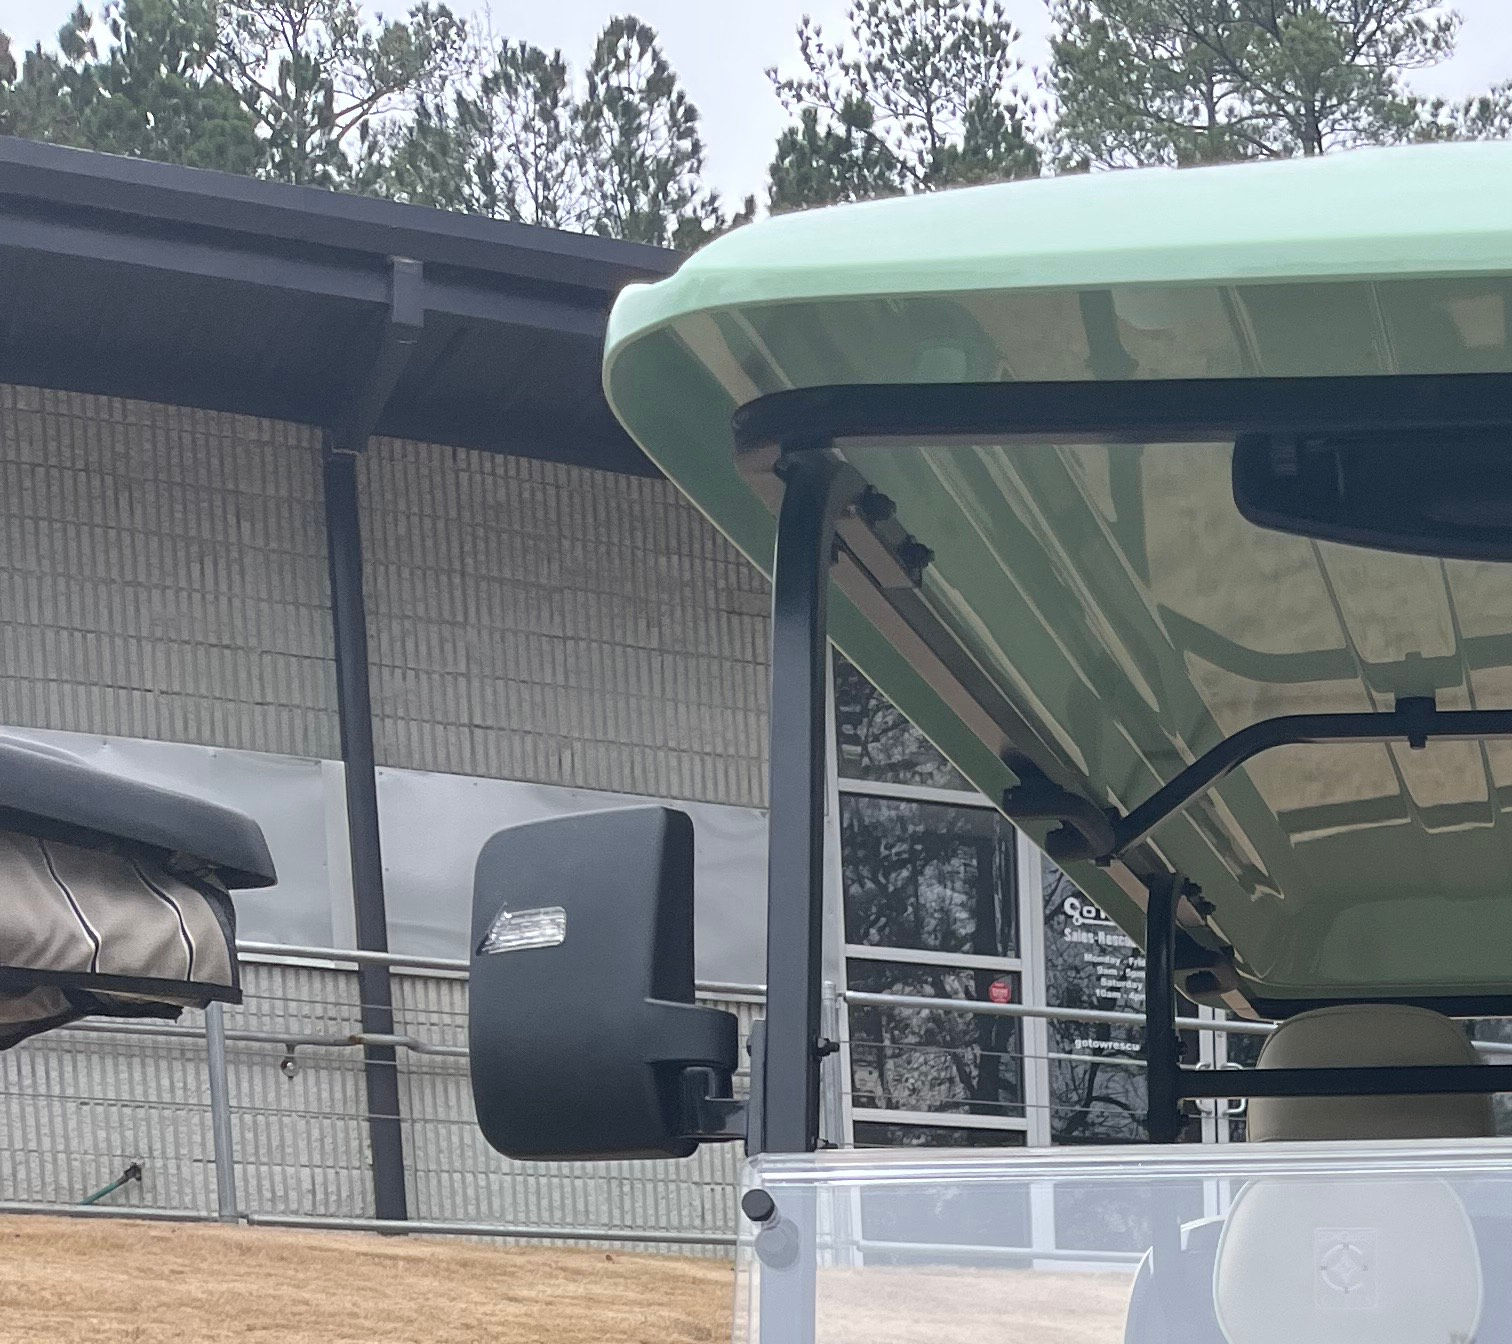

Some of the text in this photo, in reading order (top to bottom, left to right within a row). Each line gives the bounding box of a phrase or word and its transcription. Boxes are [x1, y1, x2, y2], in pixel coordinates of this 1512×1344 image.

[1084, 953, 1120, 967] Monday
[1101, 978, 1143, 990] Saturday
[1096, 989, 1121, 999] 10am
